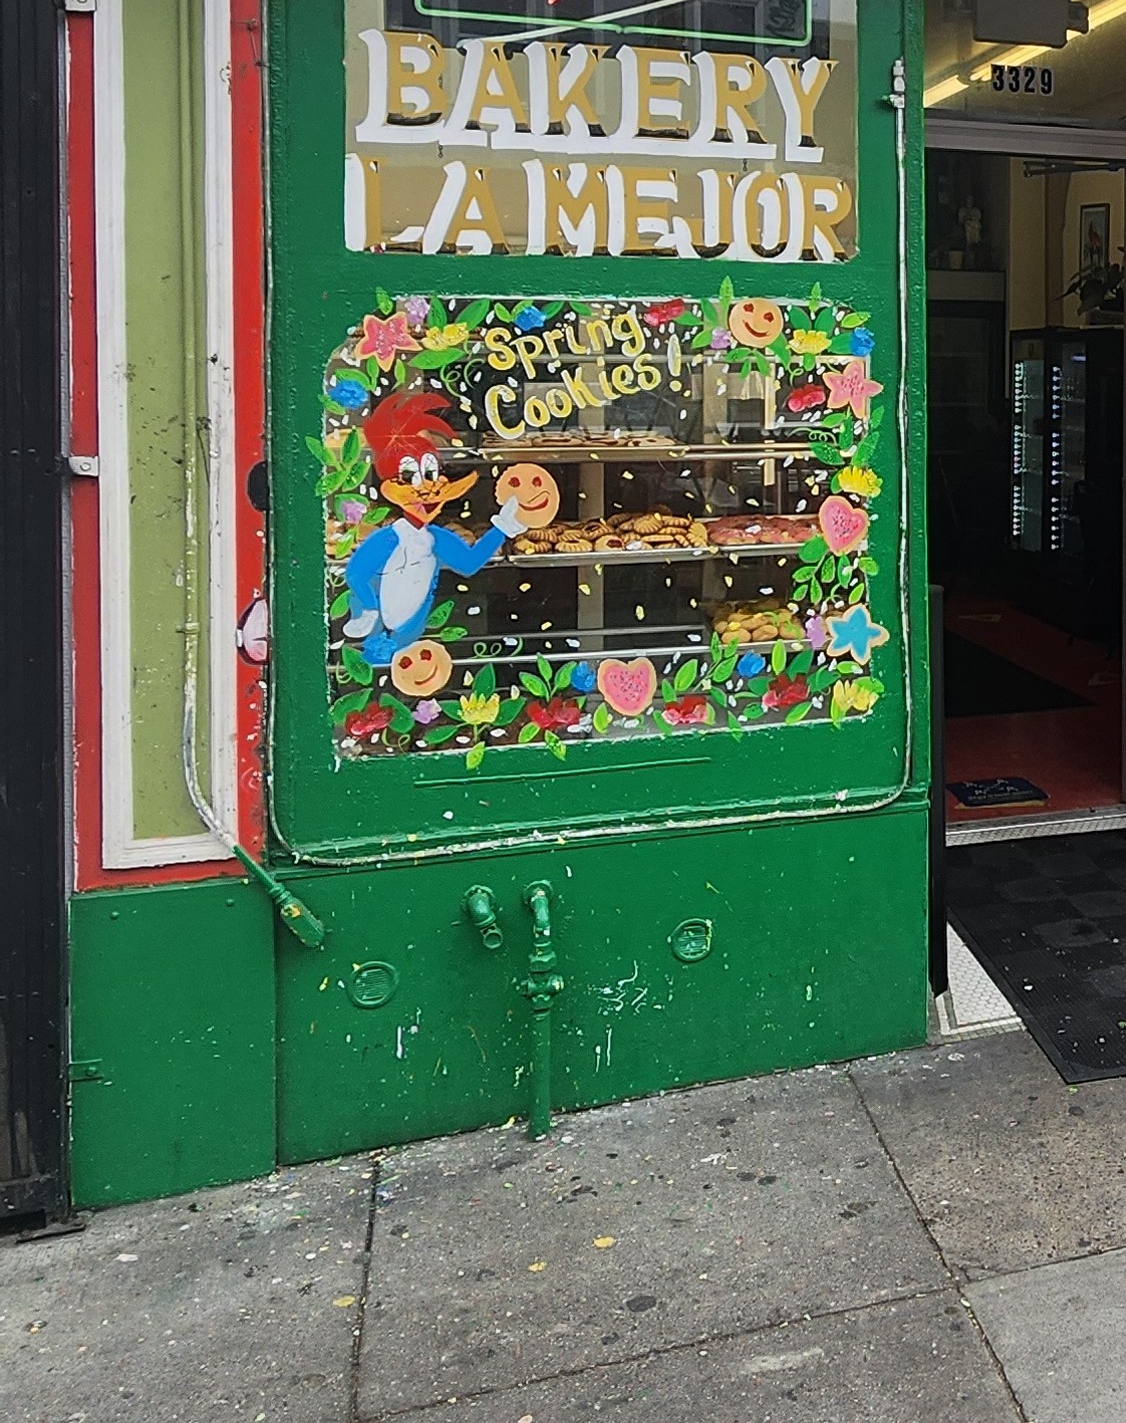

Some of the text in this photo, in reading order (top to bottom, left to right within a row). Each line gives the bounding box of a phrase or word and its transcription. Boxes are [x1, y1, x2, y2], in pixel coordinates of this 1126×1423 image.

[355, 28, 840, 163] BAKERY
[992, 65, 1053, 95] 3329
[521, 158, 855, 263] MEJOR
[484, 305, 647, 380] Spring
[484, 333, 682, 440] Cookies!
